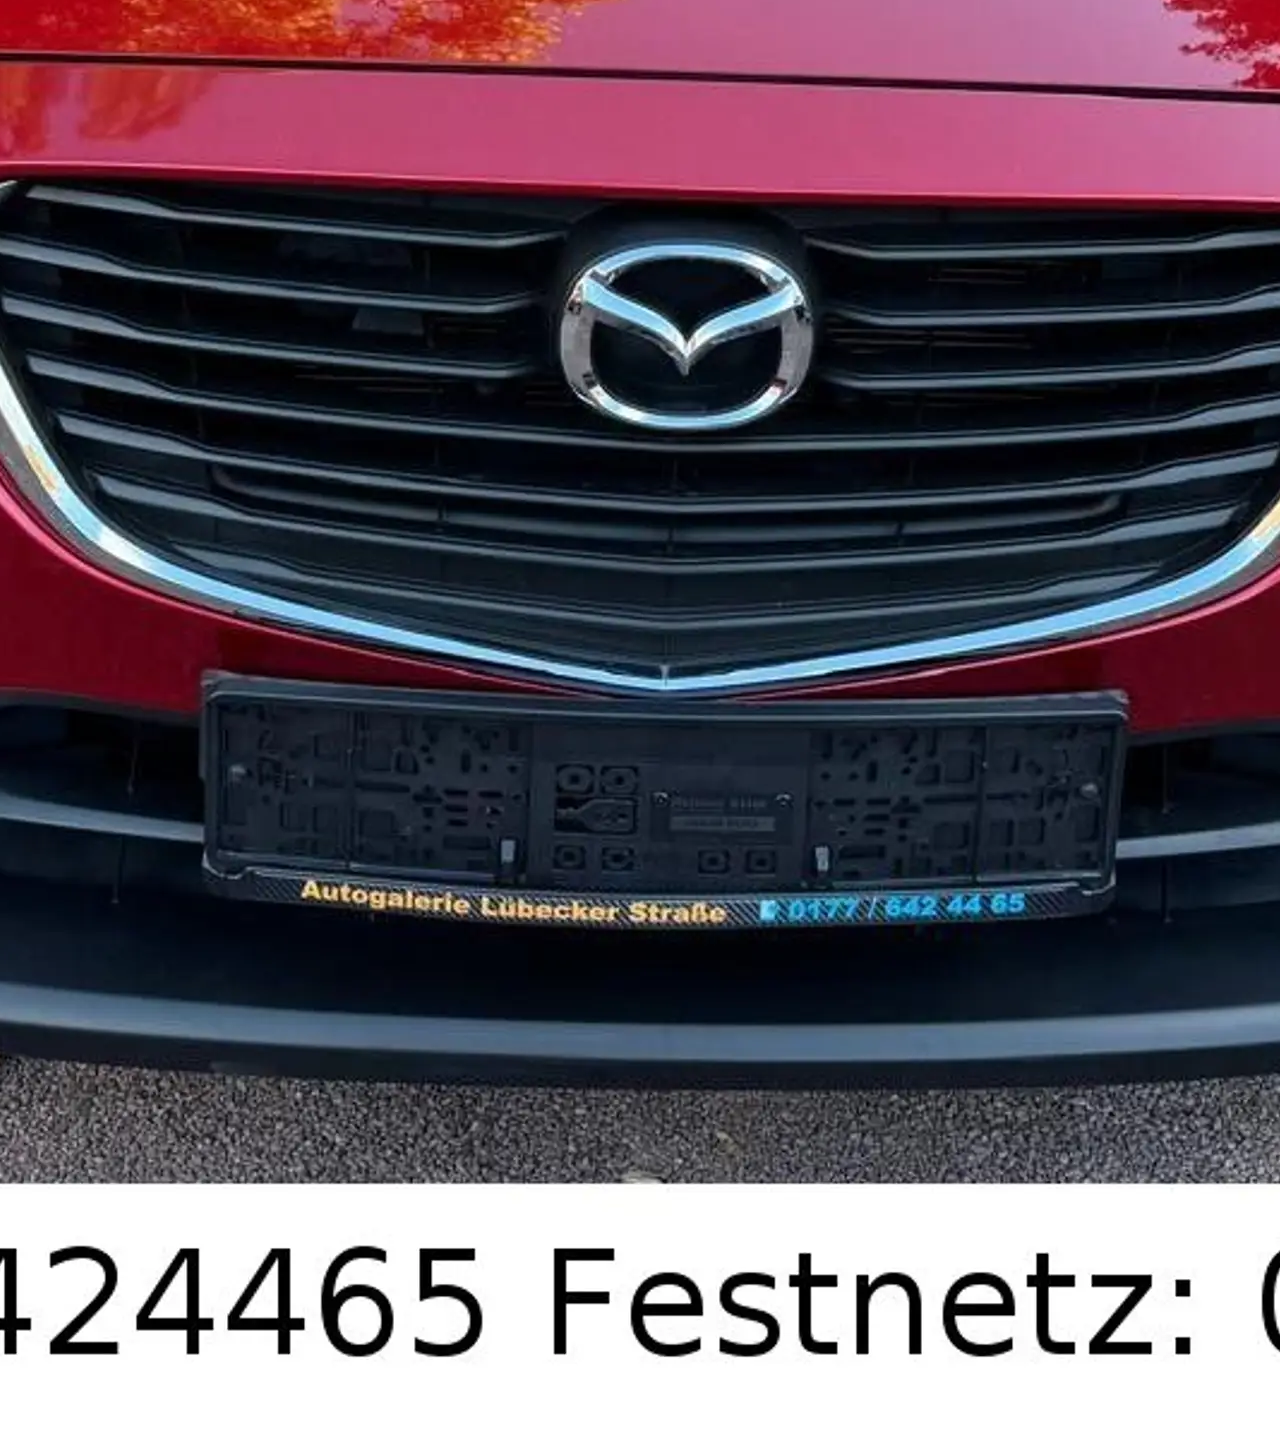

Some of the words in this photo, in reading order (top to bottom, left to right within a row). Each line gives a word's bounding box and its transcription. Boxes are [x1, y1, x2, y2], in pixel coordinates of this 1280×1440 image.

[300, 879, 470, 916] Autogalerie
[481, 897, 621, 923] Lübecker
[628, 901, 728, 924] Straße
[788, 898, 859, 922] 0177
[884, 894, 938, 918] 642
[945, 893, 982, 916] 44
[990, 892, 1026, 914] 65
